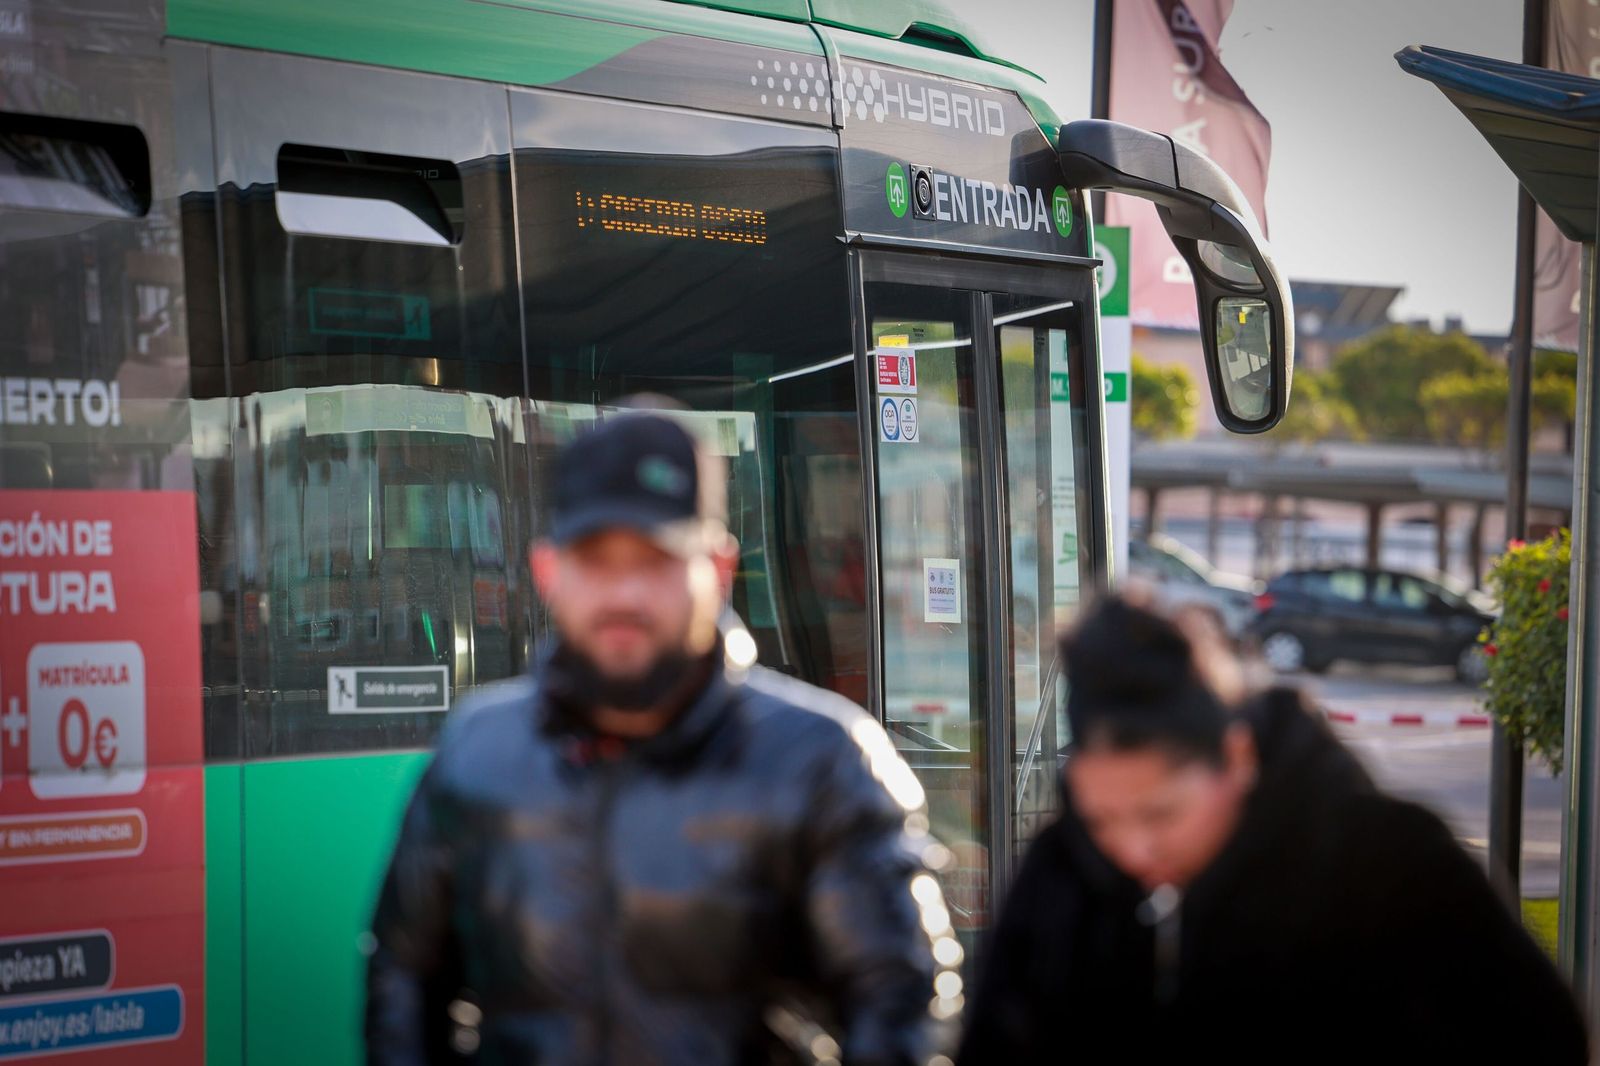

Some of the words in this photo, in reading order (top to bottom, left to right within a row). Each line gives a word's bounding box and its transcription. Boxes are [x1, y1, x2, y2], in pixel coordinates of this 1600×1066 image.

[880, 79, 1006, 137] HYBRID
[933, 173, 1051, 234] ENTRADA
[72, 520, 114, 556] DE
[0, 570, 117, 616] TURA
[38, 661, 131, 689] MATRÍCULA
[57, 696, 120, 770] 0€
[0, 949, 56, 992] pieza
[57, 944, 87, 978] YA
